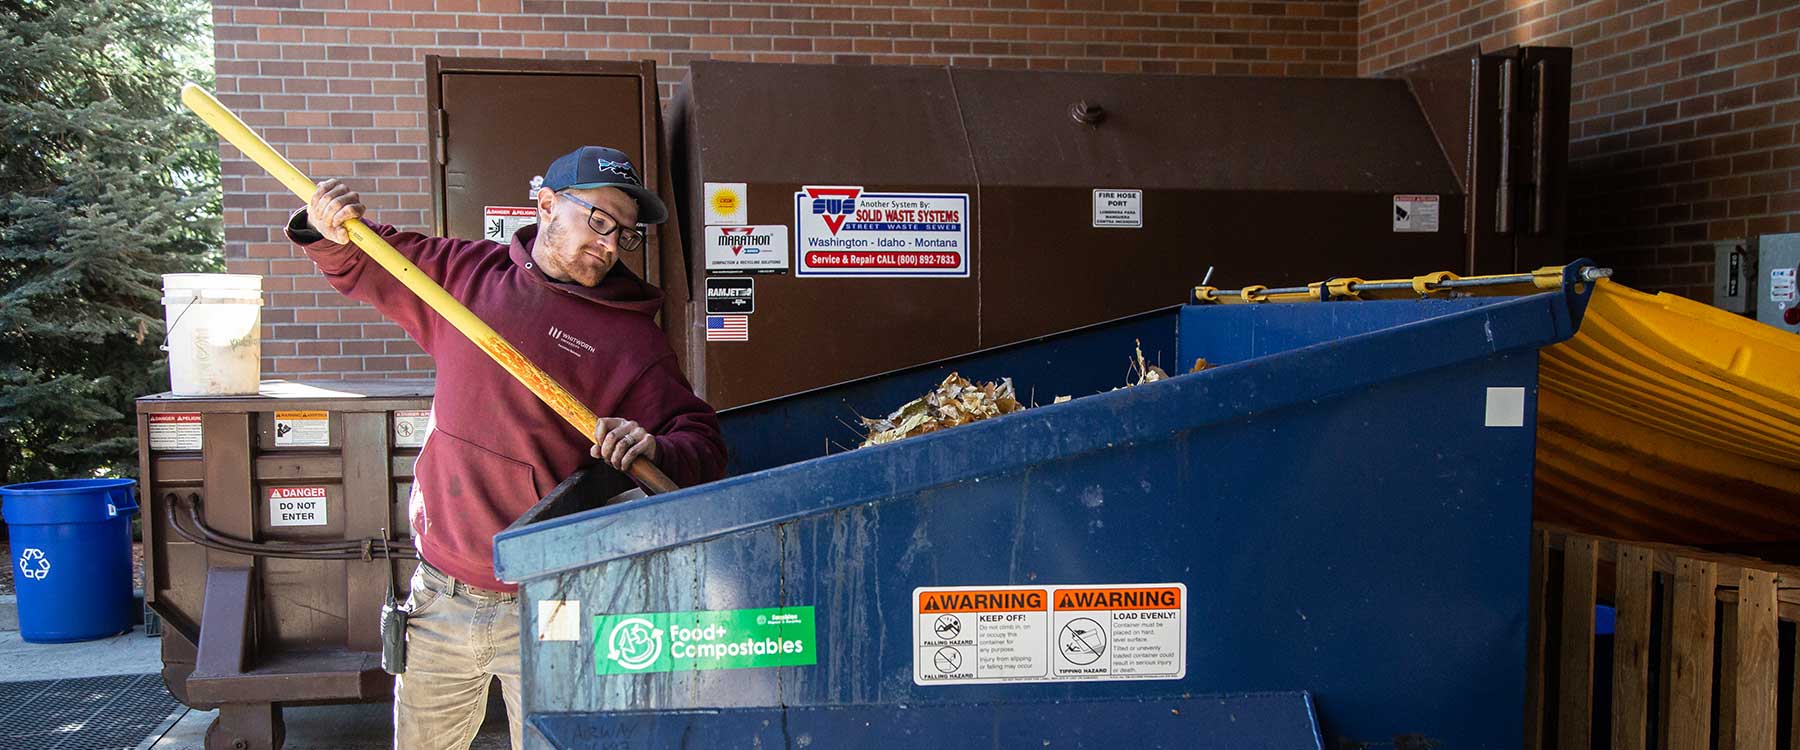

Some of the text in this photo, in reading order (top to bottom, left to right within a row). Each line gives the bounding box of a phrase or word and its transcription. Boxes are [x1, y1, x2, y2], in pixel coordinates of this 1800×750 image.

[812, 198, 855, 214] SWS
[860, 200, 930, 210] Another System By:
[856, 210, 959, 222] SOLID WASTE SYSTEMS
[808, 237, 868, 248] Washington
[878, 238, 906, 247] Idaho
[914, 238, 958, 248] Montana
[812, 254, 955, 266] Service & Repair CALL (800) 892-7831
[708, 288, 738, 296] RAMJET
[562, 332, 596, 353] WHITWORTH
[282, 488, 326, 497] DANGER
[282, 512, 314, 520] ENTER
[941, 593, 1041, 610] WARNING
[1075, 590, 1175, 608] WARNING
[670, 624, 726, 642] Food+
[671, 637, 804, 659] Compostables
